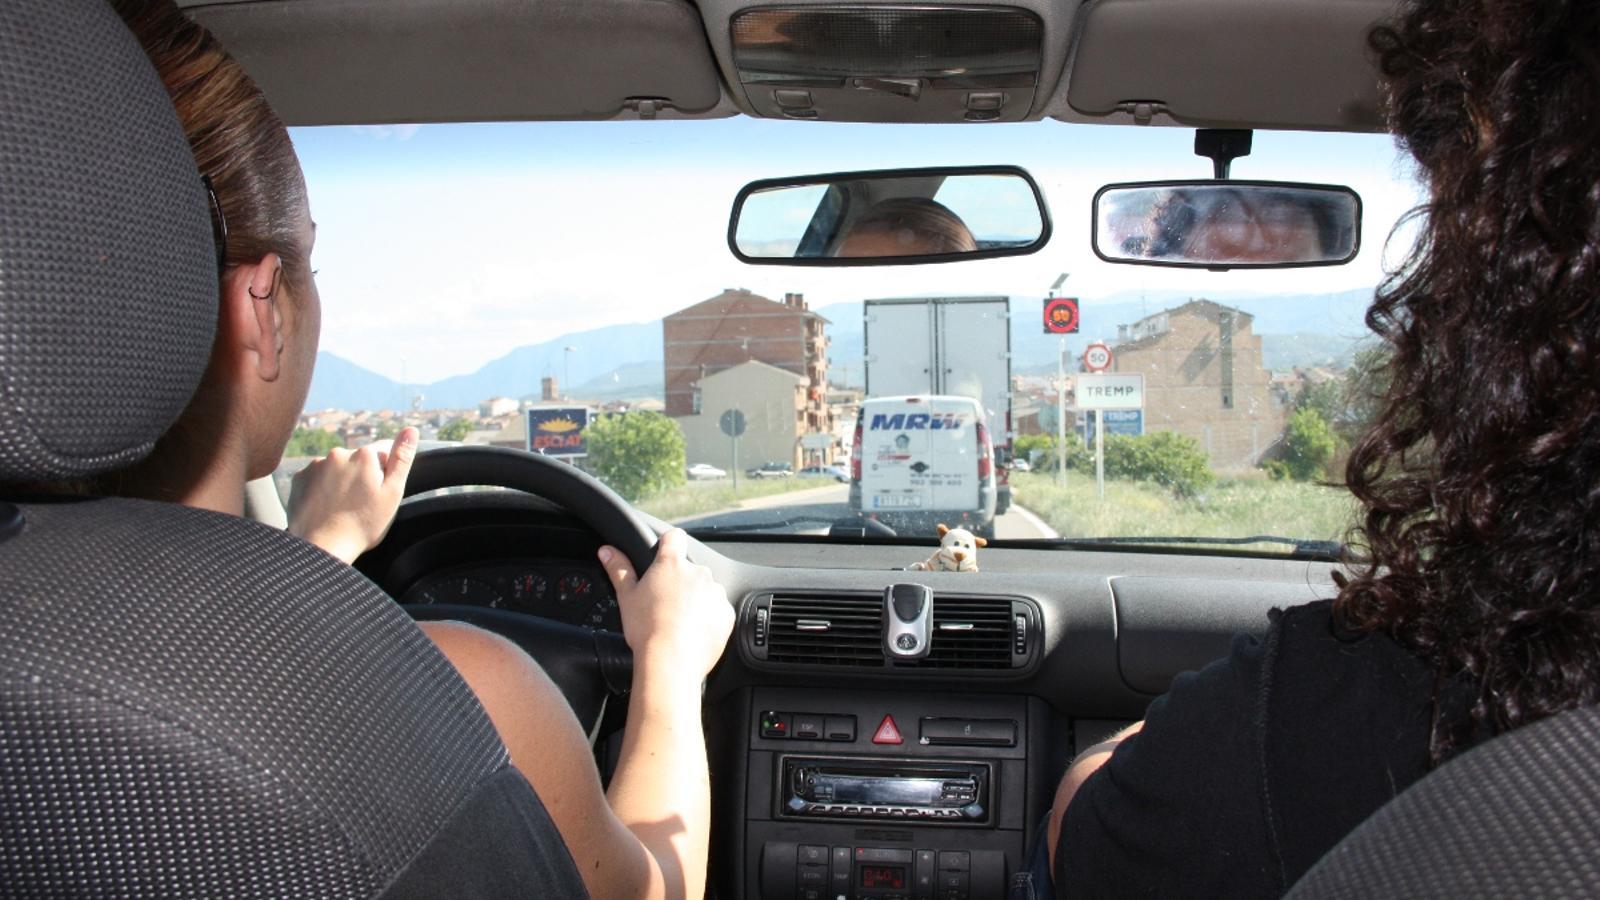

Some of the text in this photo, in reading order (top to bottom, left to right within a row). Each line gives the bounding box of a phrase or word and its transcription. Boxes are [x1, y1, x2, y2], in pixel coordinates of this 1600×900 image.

[1090, 352, 1106, 362] 50
[1086, 385, 1134, 397] TREMP
[870, 413, 968, 431] MRW
